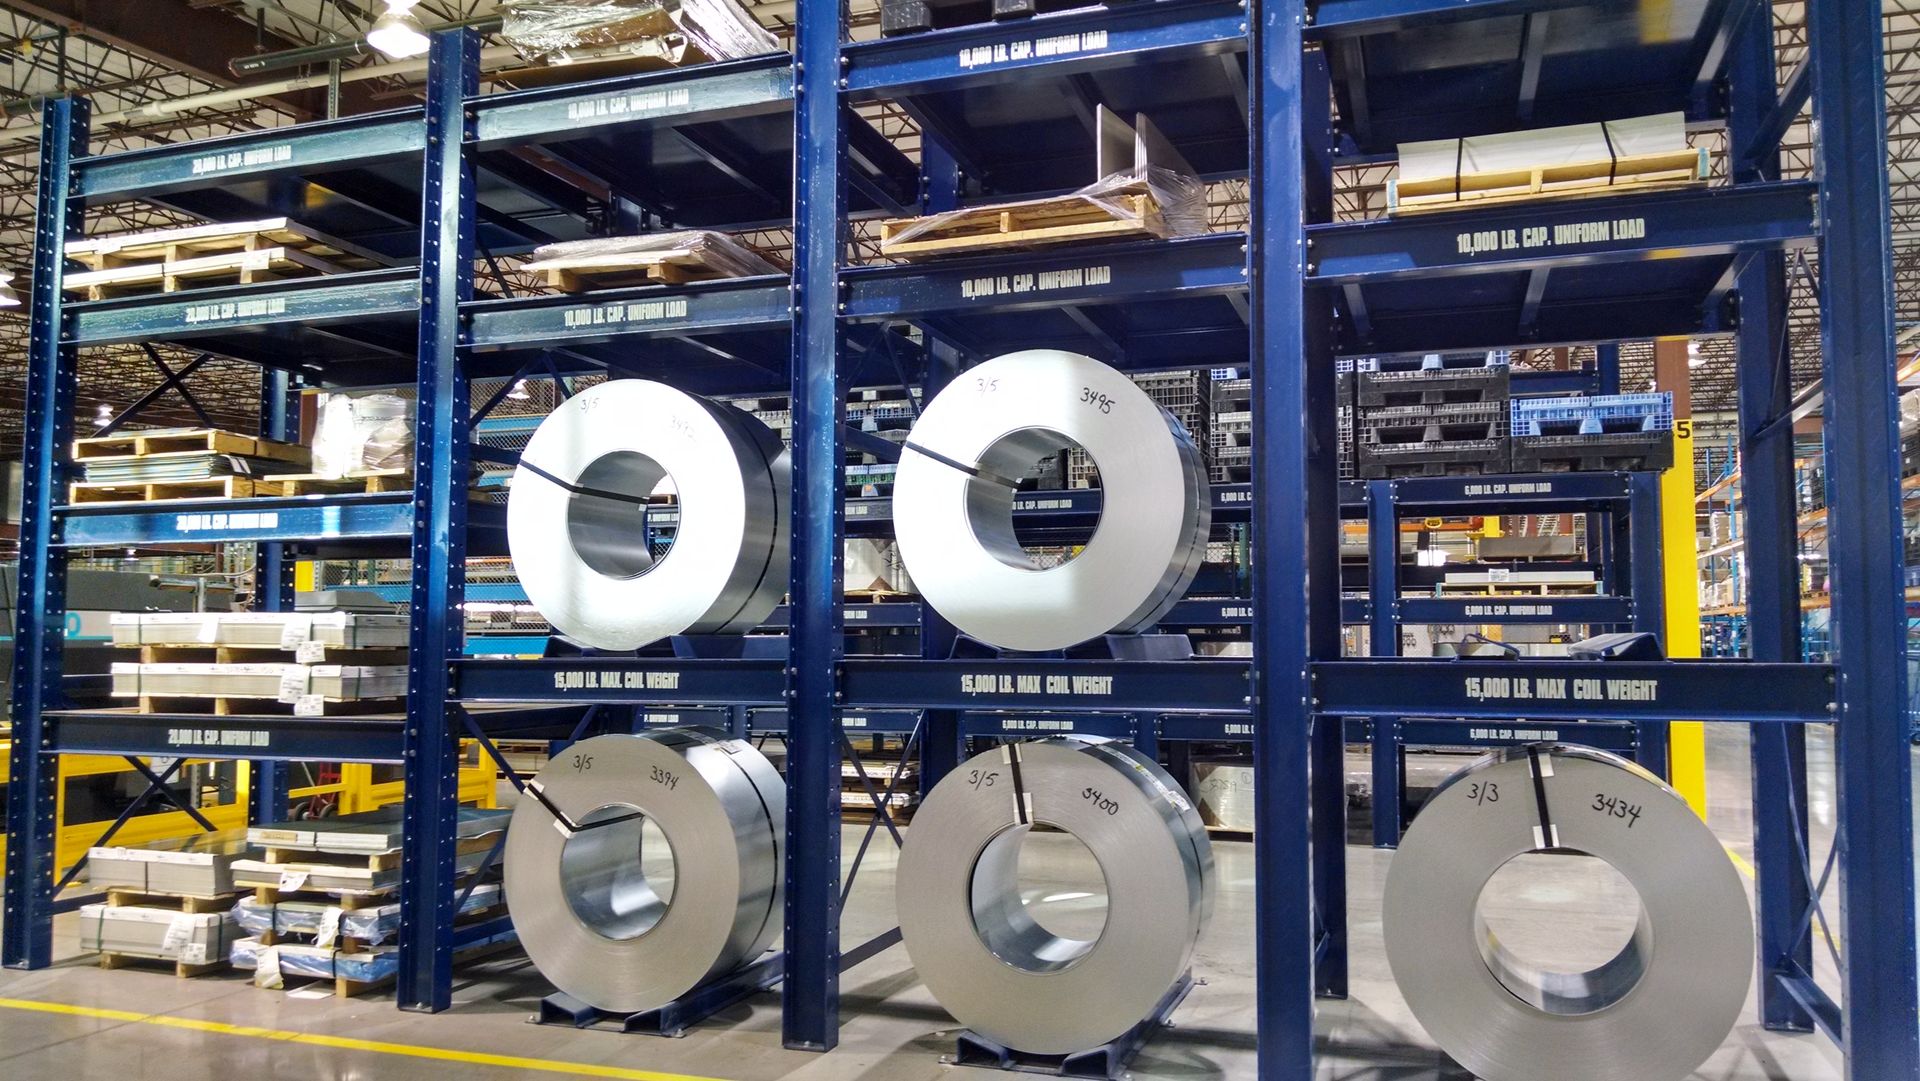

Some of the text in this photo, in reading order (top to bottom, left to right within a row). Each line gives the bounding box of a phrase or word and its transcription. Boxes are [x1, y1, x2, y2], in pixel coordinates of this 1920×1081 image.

[960, 30, 1107, 69] 10,000 LB. CAP. UNIFORM LOAD
[610, 97, 630, 113] CAP.
[631, 91, 666, 111] UNIFORM
[668, 89, 689, 106] LOAD
[1457, 218, 1645, 256] 10,000 LB. CAP. UNIFORM LOAD
[961, 266, 1110, 300] 10,000 LB. CAP. UNIFORM LOAD
[565, 301, 686, 329] 10,000 LB. CAP. UNIFORM LOAD
[976, 377, 1000, 398] 3/5
[581, 397, 600, 413] 3/5
[1080, 387, 1115, 414] 3495
[1677, 421, 1690, 438] 5
[554, 671, 679, 691] 15,000 LB. MAX. COIL WEIGHT
[961, 674, 1113, 696] 15,000 LB. MAX COIL WEIGHT
[1465, 678, 1657, 701] 15,000 LB. MAX COIL WEIGHT
[573, 754, 593, 773] 3/5
[650, 765, 679, 790] 3394
[968, 770, 999, 791] 3/5
[1082, 788, 1118, 815] 3400
[1467, 781, 1499, 806] 3/3
[1592, 794, 1642, 828] 3434
